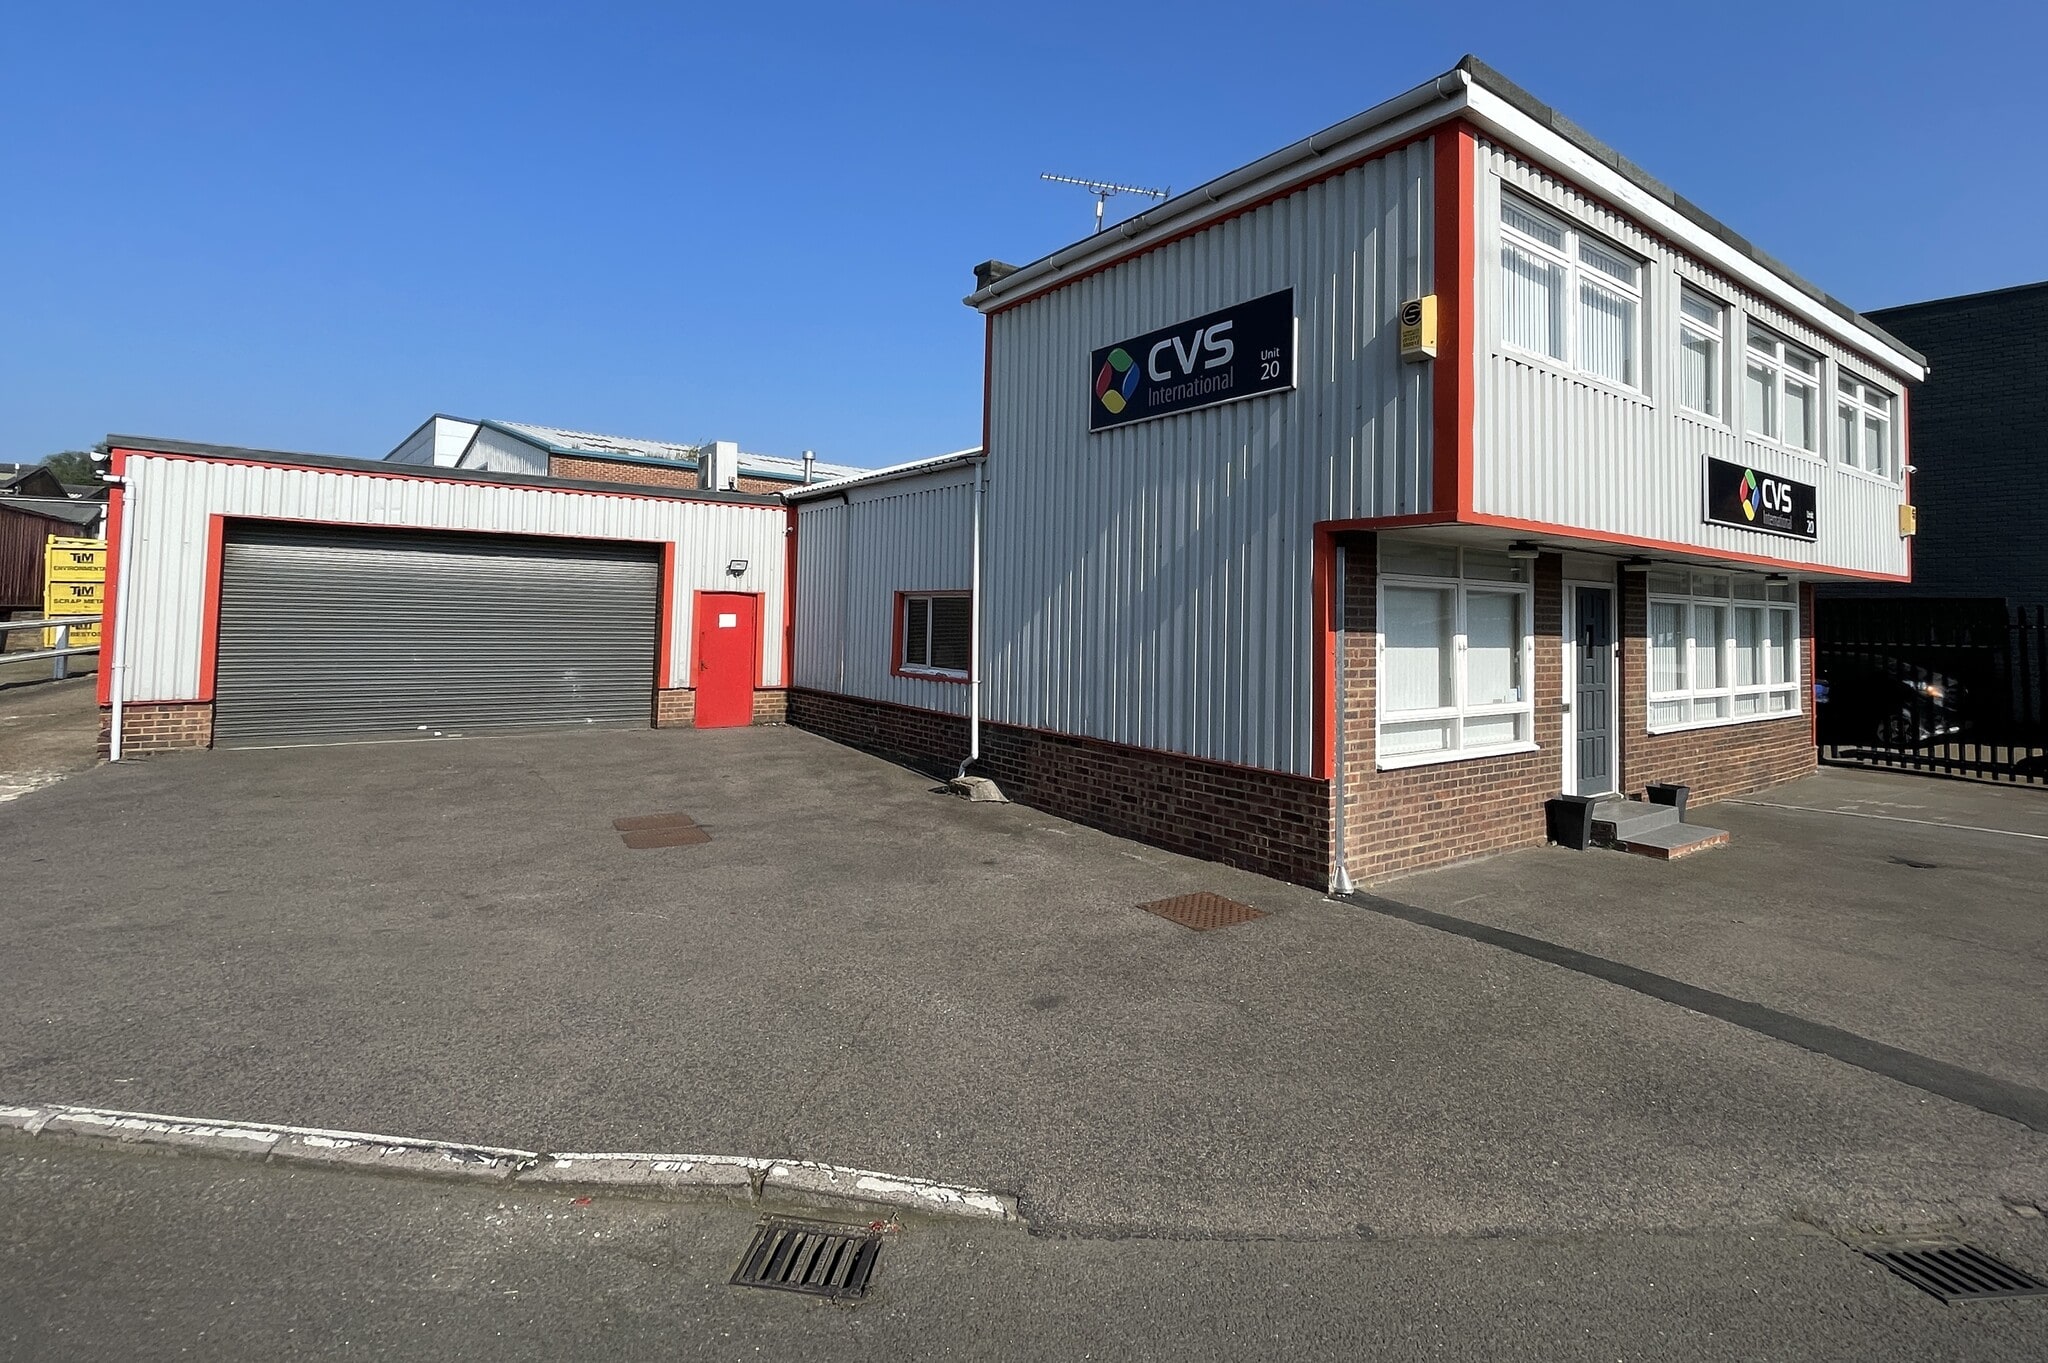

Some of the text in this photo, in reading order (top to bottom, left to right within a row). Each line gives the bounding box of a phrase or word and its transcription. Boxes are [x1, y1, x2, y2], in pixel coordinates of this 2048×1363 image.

[1148, 320, 1234, 382] CVS
[1260, 347, 1280, 361] Unit
[1260, 360, 1280, 381] 20
[1149, 366, 1234, 407] International
[1762, 478, 1792, 513] CVS
[1806, 520, 1815, 534] 20
[70, 553, 94, 564] TLM
[70, 586, 94, 597] TLM
